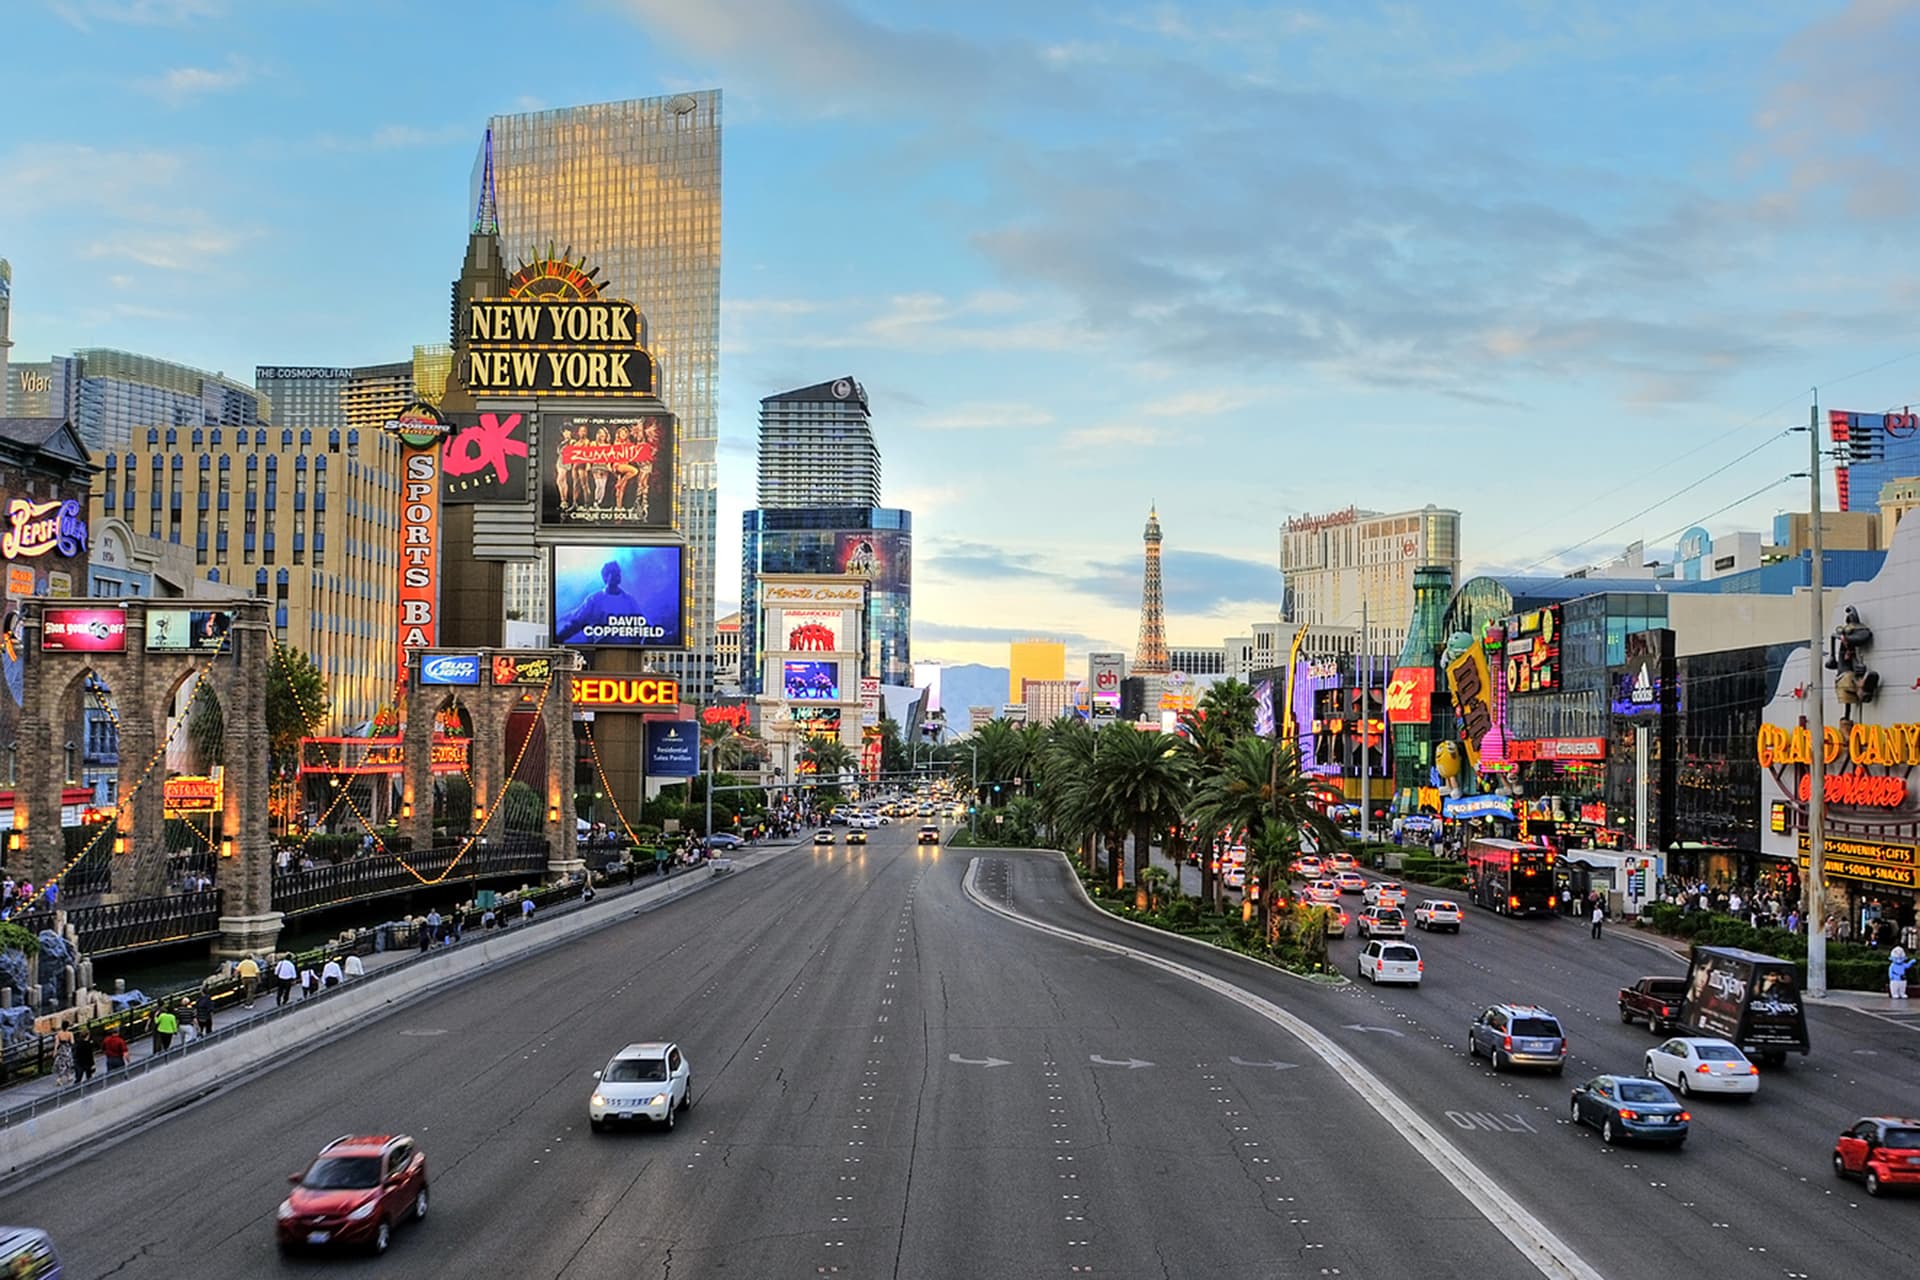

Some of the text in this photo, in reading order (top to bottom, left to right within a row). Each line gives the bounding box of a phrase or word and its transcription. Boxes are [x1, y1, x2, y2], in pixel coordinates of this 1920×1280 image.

[470, 305, 632, 341] NEW YORK
[257, 368, 353, 379] THE COSMOPOLITAN
[468, 352, 632, 388] NEW YORK
[570, 443, 643, 463] ZUMANITY
[1288, 504, 1355, 535] hollywood
[402, 455, 434, 667] SPORTS BA
[608, 616, 647, 626] DAVID
[583, 626, 664, 637] COPPERFIELD
[431, 669, 476, 678] LIGHT
[439, 661, 473, 669] BUD
[1799, 764, 1908, 807] eperience
[1837, 842, 1881, 857] SOUVENIRS
[1886, 848, 1910, 861] GIFTS
[1849, 864, 1872, 877] SODA
[1876, 867, 1910, 882] SNACKS
[1445, 1110, 1538, 1133] ONLY
